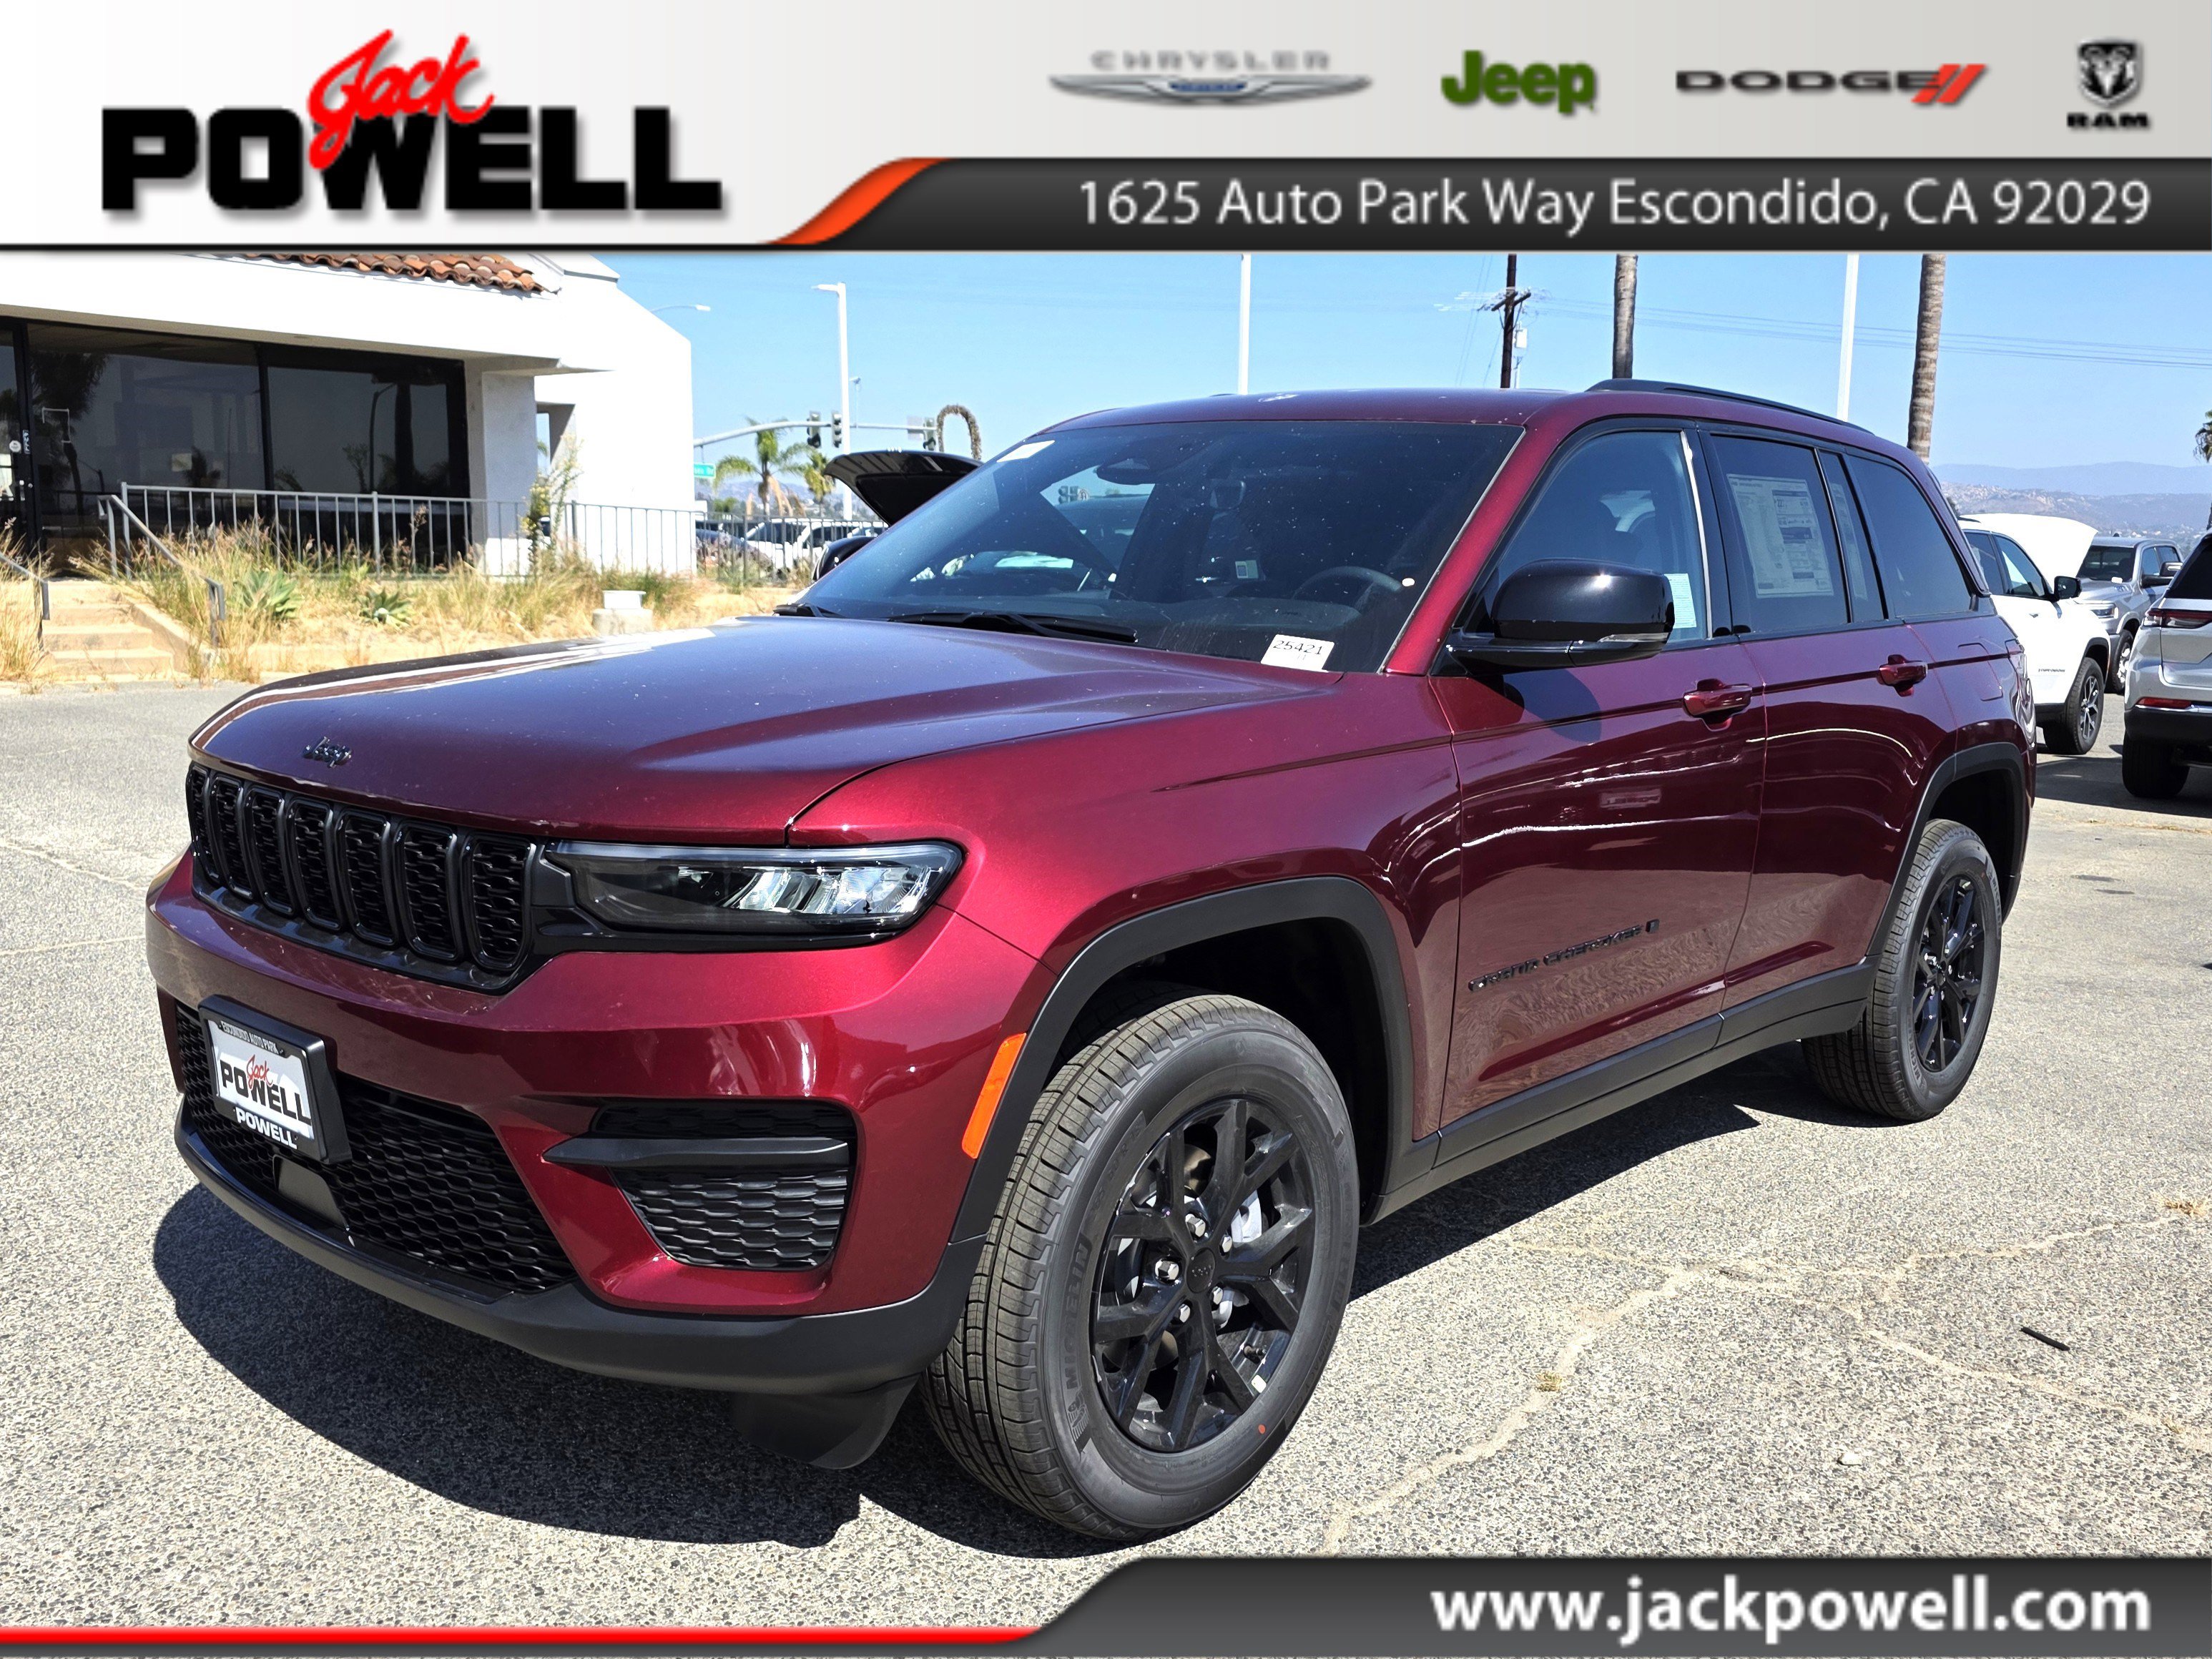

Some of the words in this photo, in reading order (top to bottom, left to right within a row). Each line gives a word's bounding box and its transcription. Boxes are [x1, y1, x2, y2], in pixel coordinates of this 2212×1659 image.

[1273, 641, 1323, 655] 25421
[303, 736, 353, 768] Jeep
[247, 1054, 273, 1090] Jack
[220, 1059, 313, 1126] POWELL
[235, 1106, 298, 1150] POWELL
